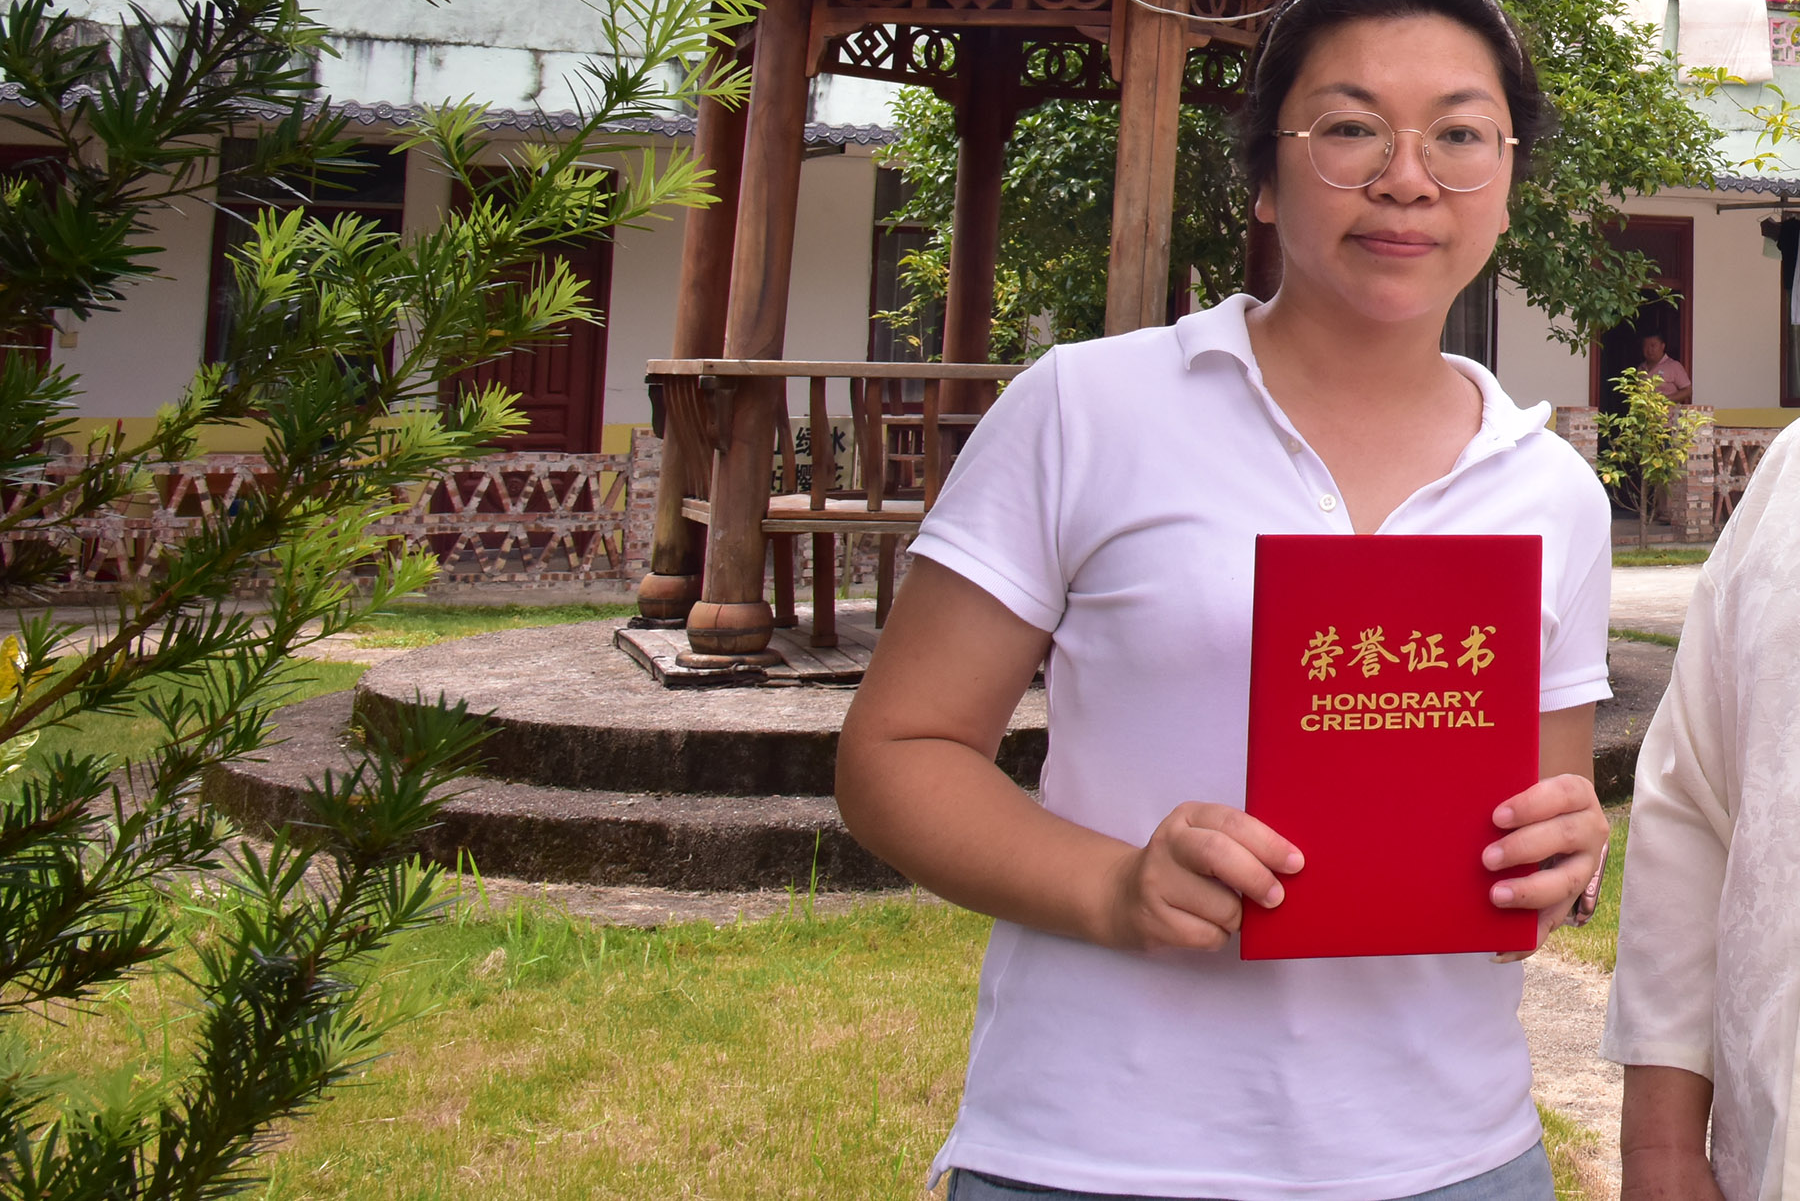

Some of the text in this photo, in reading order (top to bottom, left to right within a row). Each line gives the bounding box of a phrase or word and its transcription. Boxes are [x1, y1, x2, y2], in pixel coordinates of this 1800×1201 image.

[1301, 625, 1497, 681] 荣誉证书
[1312, 691, 1483, 711] HONORARY
[1300, 710, 1495, 732] CREDENTIAL
